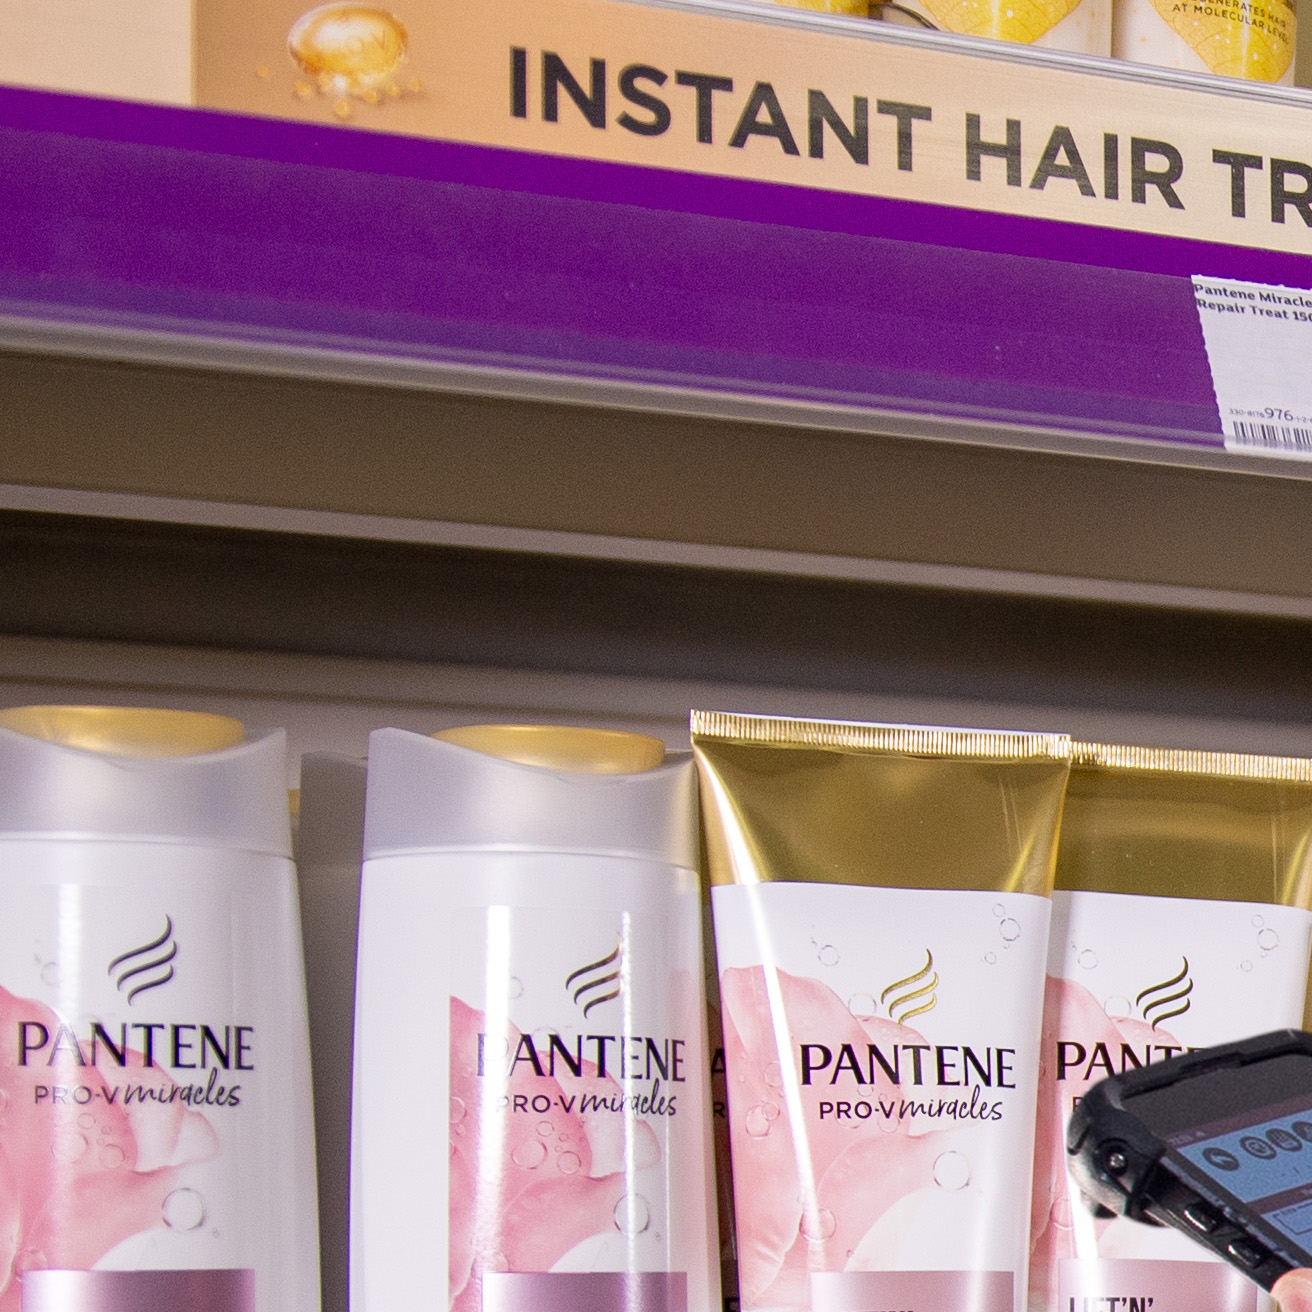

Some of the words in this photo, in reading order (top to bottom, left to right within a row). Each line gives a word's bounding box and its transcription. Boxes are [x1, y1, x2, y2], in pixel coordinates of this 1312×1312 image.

[1172, 3, 1188, 12] AT
[1193, 5, 1265, 28] MOLECULAR
[508, 45, 932, 172] INSTANT
[965, 112, 1185, 210] HAIR
[1193, 284, 1256, 301] Pantene
[1197, 298, 1246, 315] Repair
[1249, 305, 1289, 320] Treat
[17, 1020, 255, 1071] PANTENE
[800, 1043, 1017, 1089] PANTENE
[34, 1085, 119, 1105] PRO-V
[124, 1067, 242, 1108] miracles
[818, 1101, 896, 1120] PRO-V
[898, 1084, 1004, 1122] miracles
